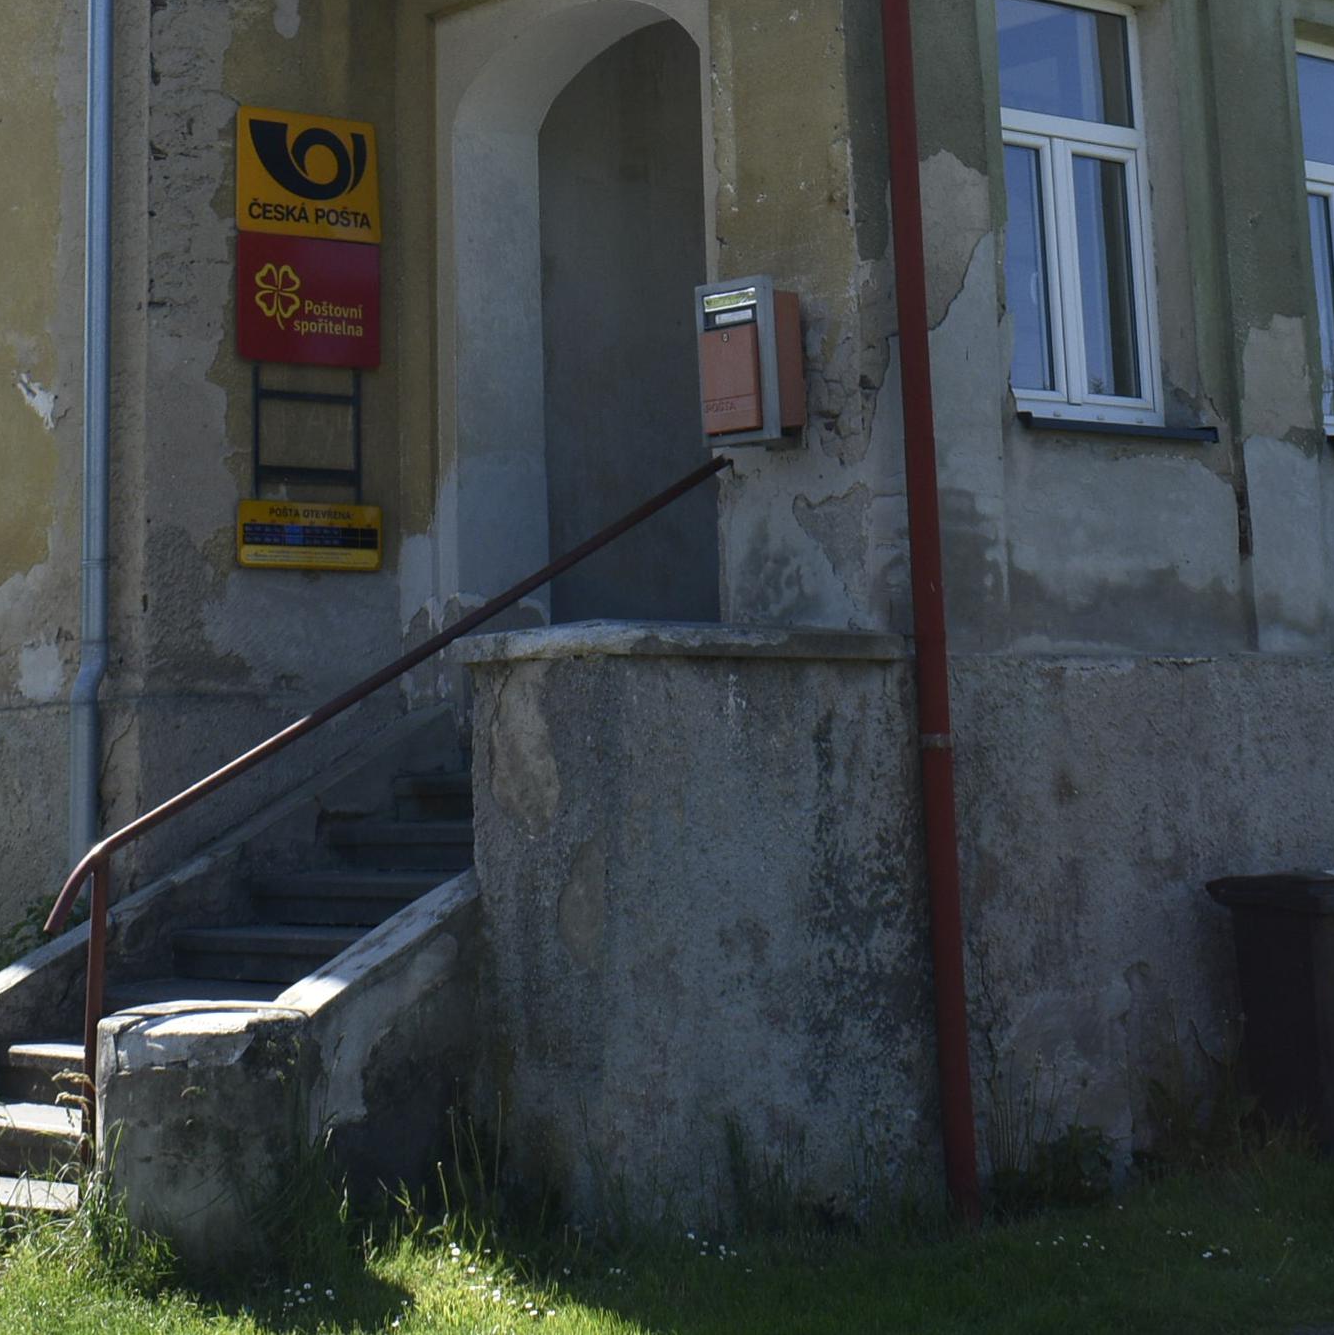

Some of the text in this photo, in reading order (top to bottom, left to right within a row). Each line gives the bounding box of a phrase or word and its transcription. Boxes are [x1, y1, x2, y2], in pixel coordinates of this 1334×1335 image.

[248, 198, 371, 229] ČESKÁ POŠTA
[304, 300, 362, 319] Poštovní
[293, 317, 363, 337] spořitelna
[269, 505, 300, 517] POŠTA
